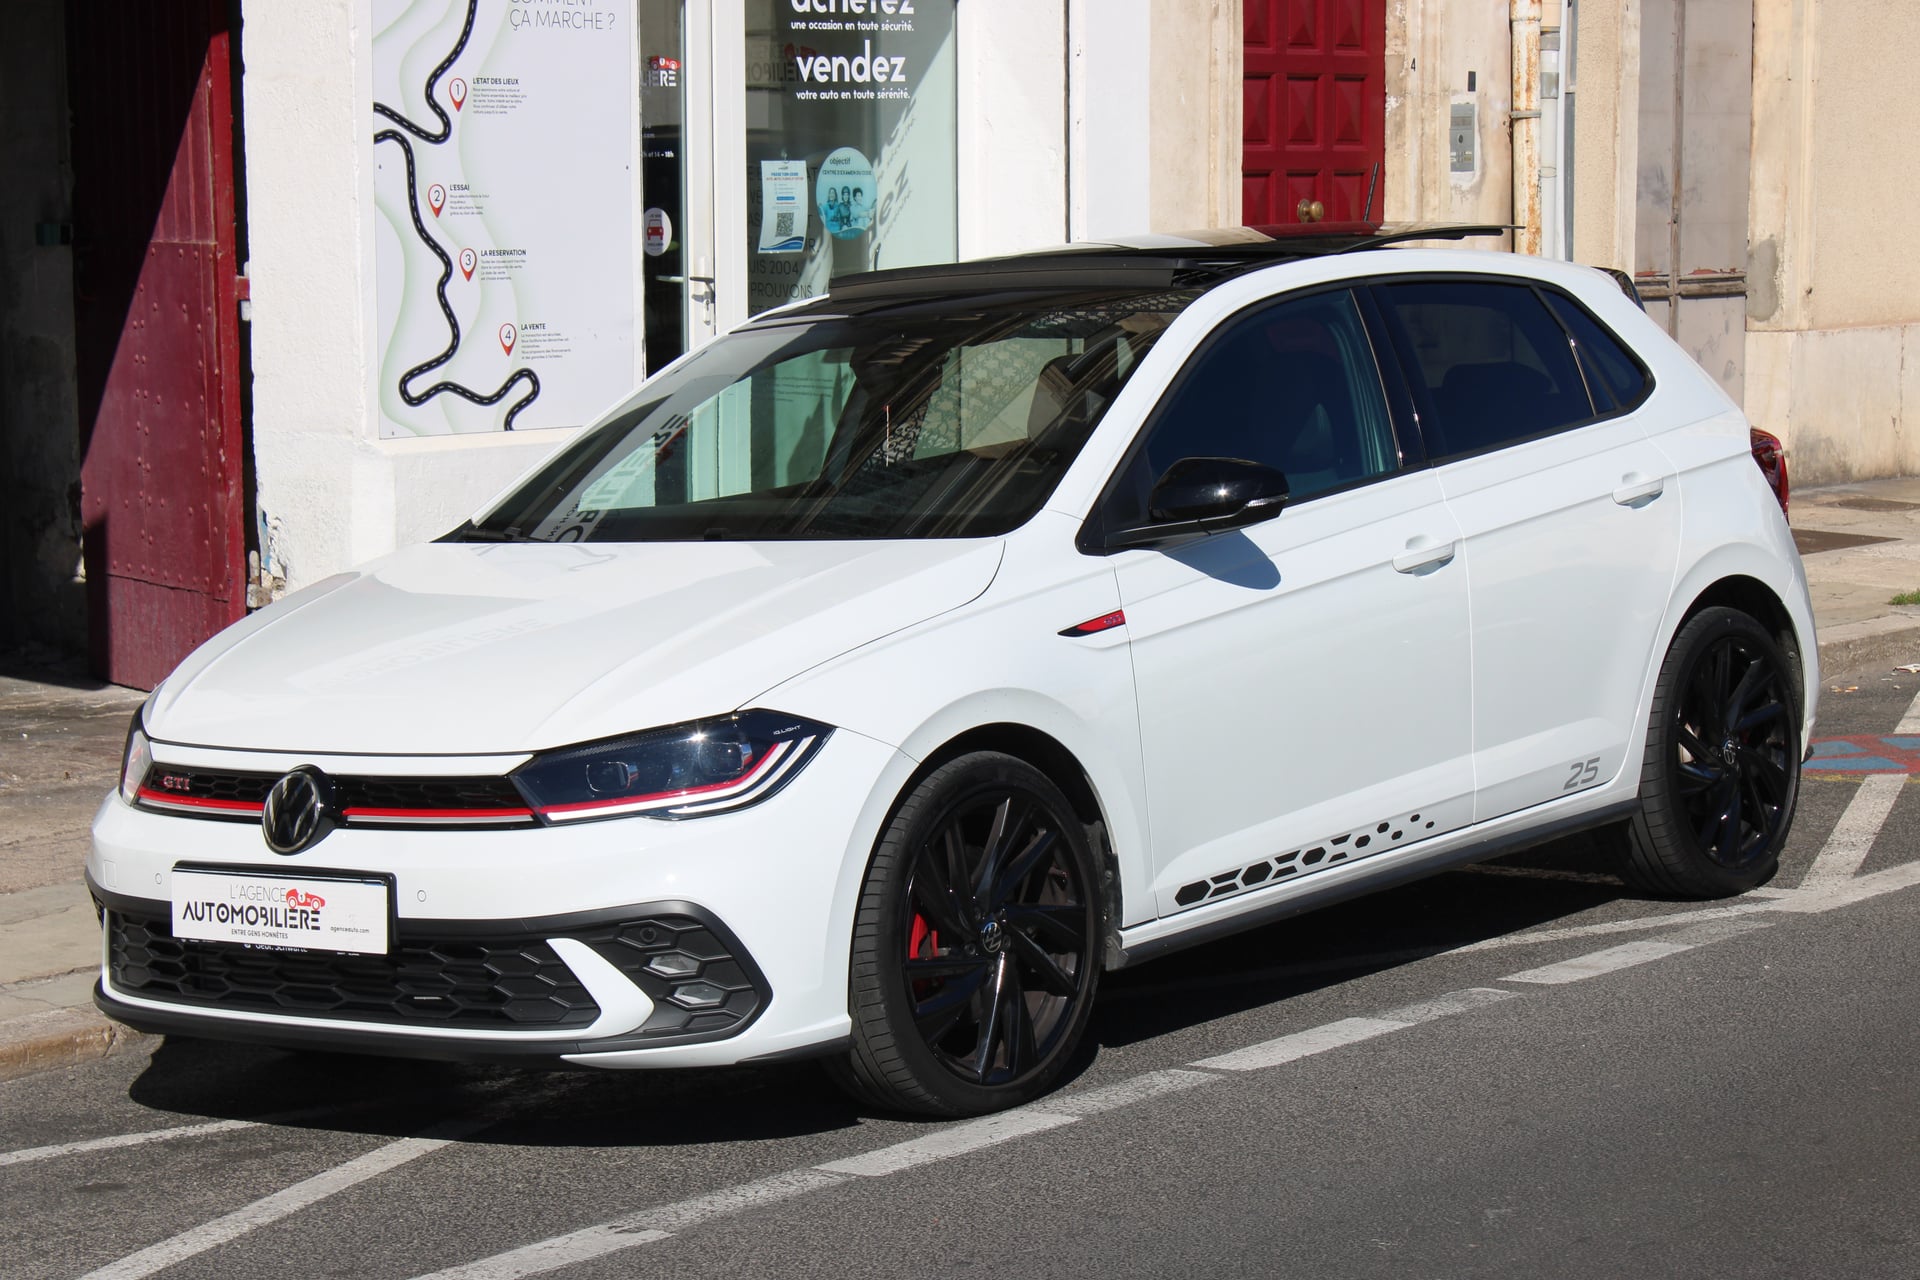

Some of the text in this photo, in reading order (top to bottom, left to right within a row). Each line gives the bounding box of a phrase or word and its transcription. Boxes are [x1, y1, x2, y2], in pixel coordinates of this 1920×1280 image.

[510, 9, 616, 31] ÇA MARCHE ?
[791, 19, 915, 32] une occasion en toute sécurité.
[796, 39, 906, 83] vendez
[1410, 57, 1417, 72] 4
[502, 78, 519, 86] LIEUX
[796, 88, 911, 101] votre auto en toute sérénité.
[433, 189, 441, 202] 2
[465, 253, 472, 266] 3
[505, 329, 511, 341] 4
[1563, 756, 1601, 790] 25
[163, 775, 190, 791] GTI
[229, 884, 288, 903] L'AGENCE
[182, 900, 321, 931] AUTOMOBILIERE
[231, 929, 289, 940] ENTRE GENS HONNÊTES
